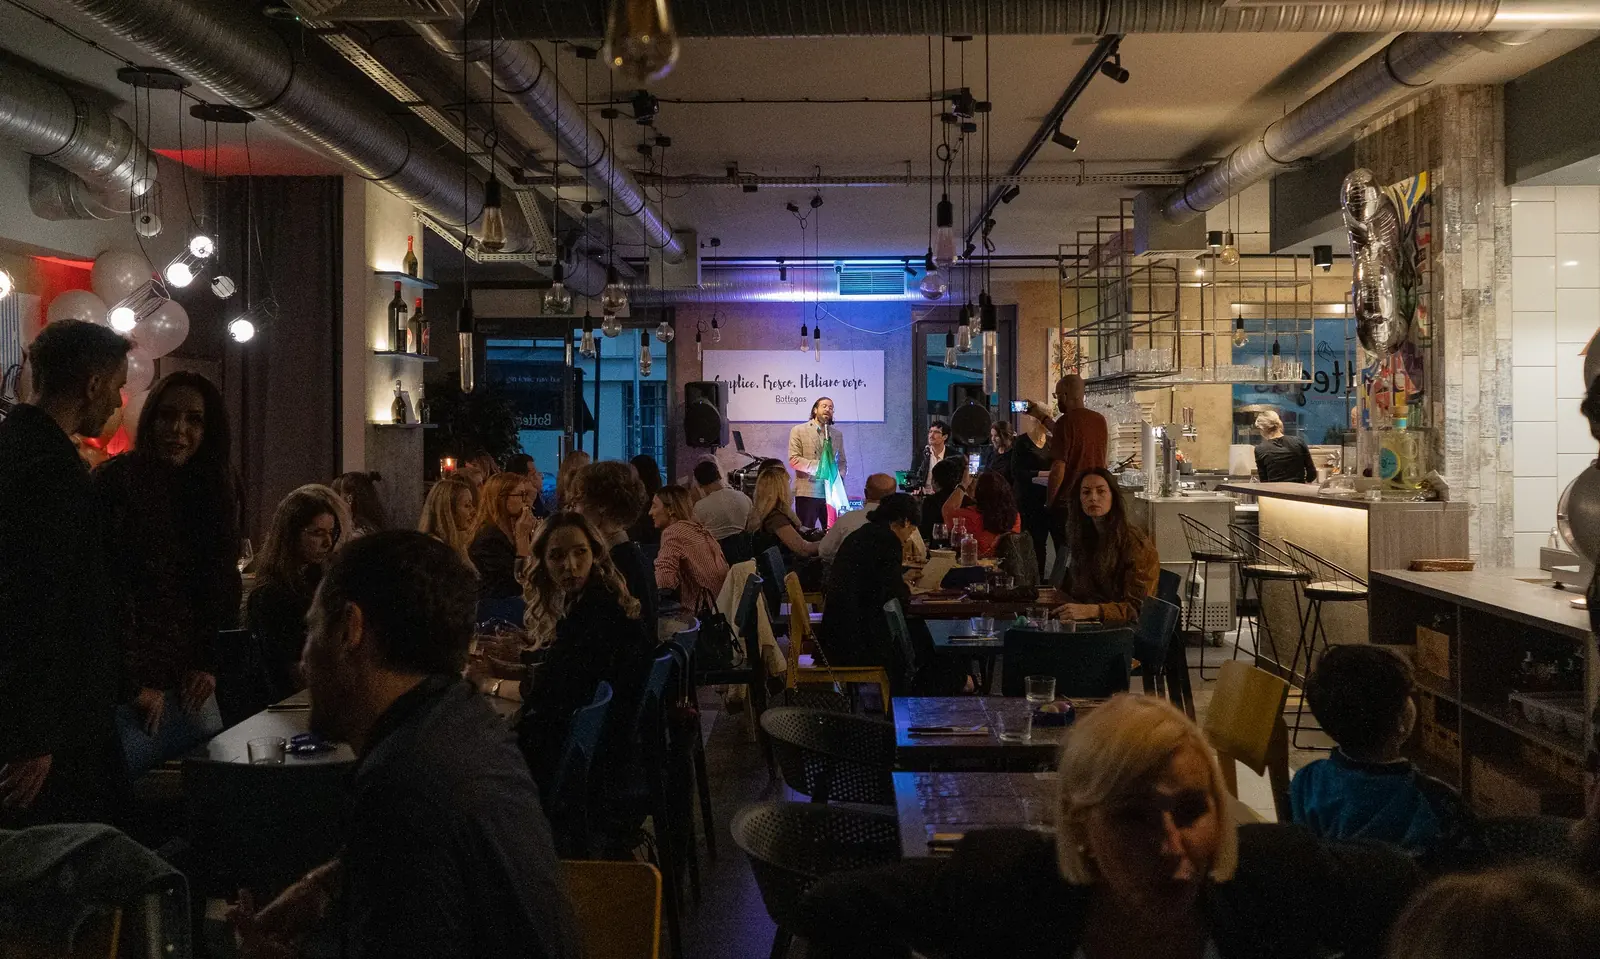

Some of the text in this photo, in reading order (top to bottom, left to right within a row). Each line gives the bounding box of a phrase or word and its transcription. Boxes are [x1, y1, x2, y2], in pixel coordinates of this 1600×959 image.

[714, 373, 867, 394] plice. Fresco. Italiano vero.
[775, 395, 807, 405] Bottegas
